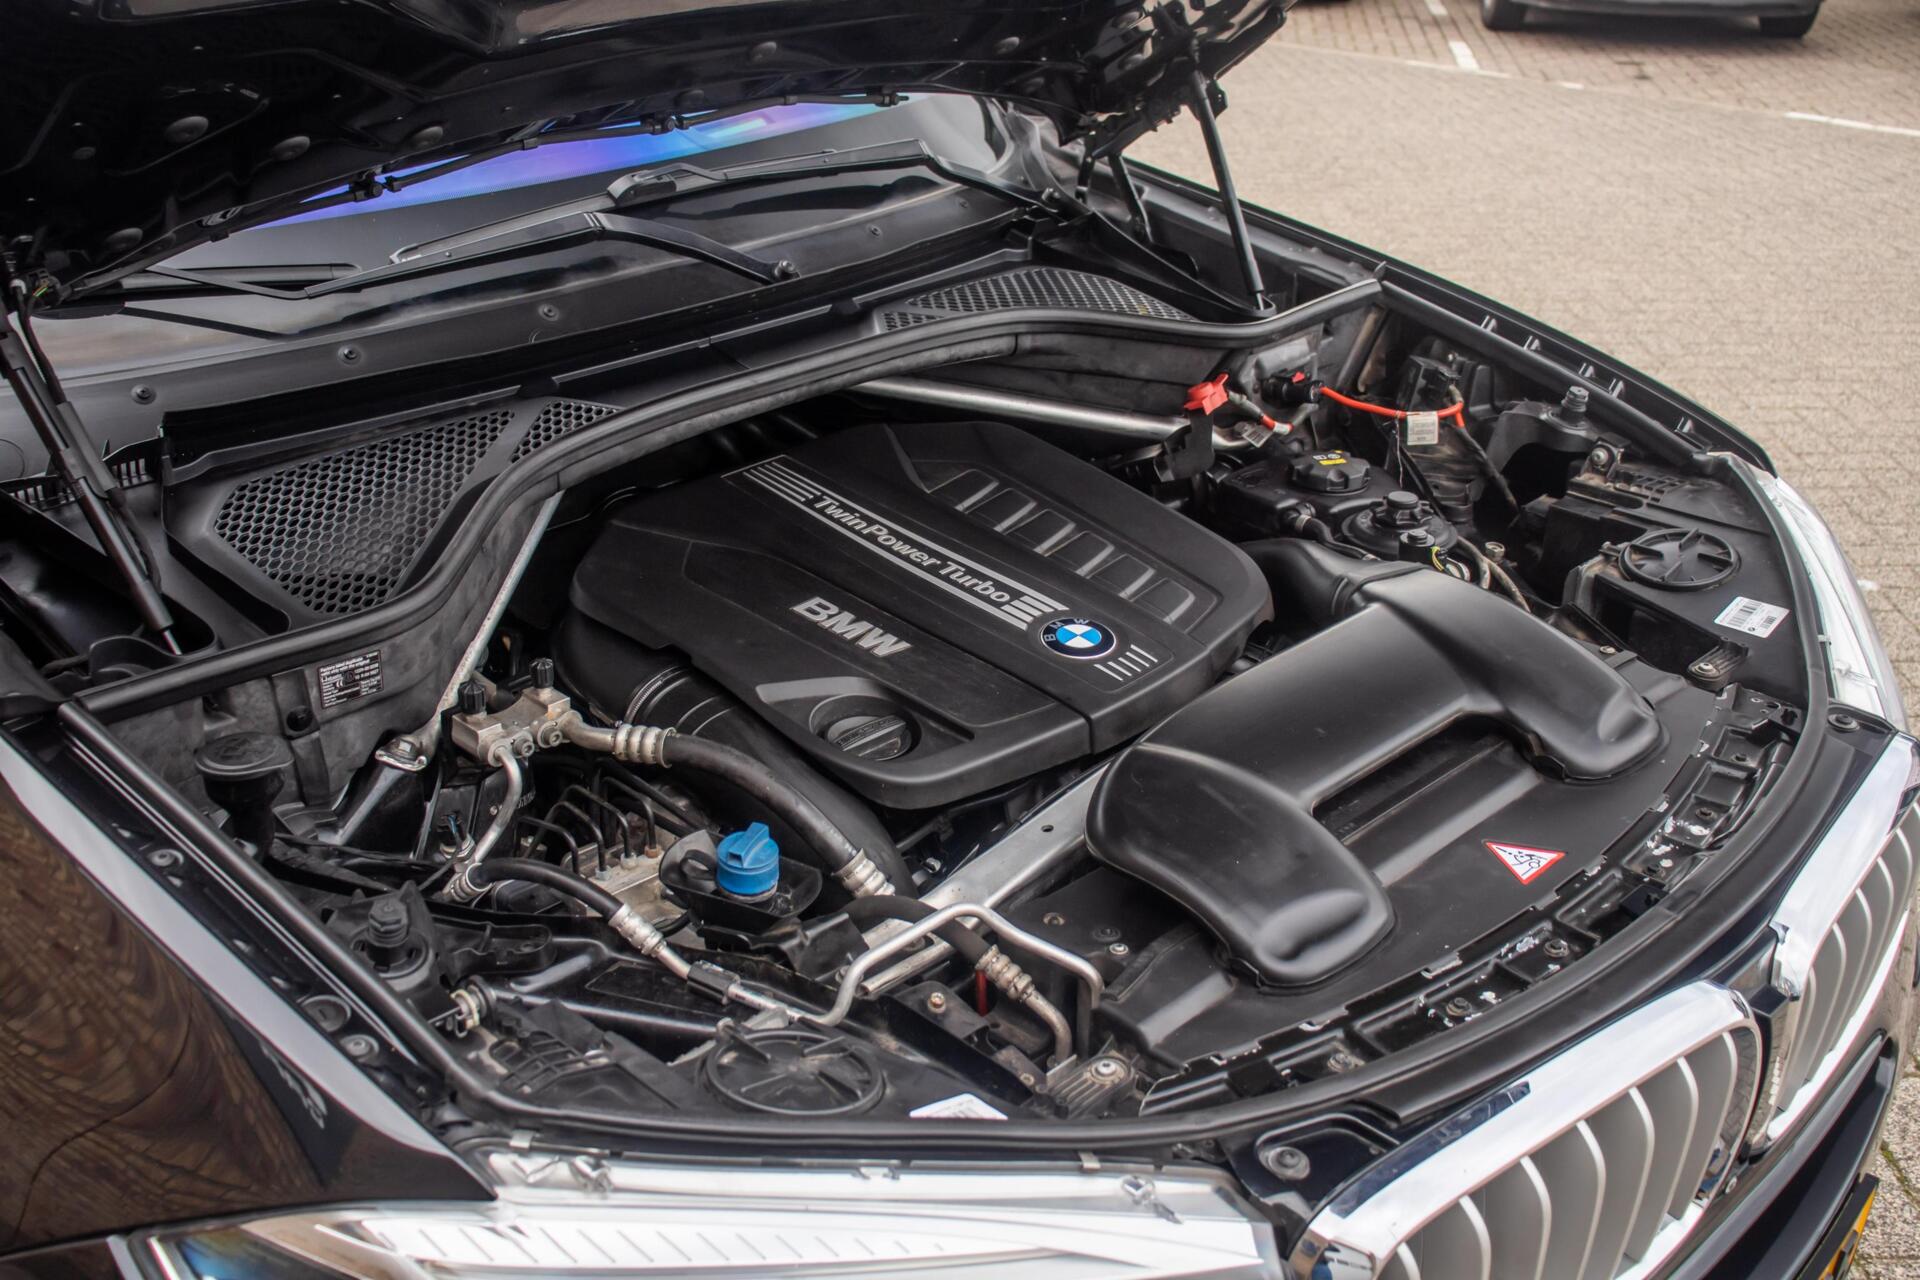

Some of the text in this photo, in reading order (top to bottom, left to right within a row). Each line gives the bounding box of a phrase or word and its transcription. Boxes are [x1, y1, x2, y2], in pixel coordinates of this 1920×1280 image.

[814, 495, 1010, 602] TwinPower Turbo
[789, 596, 912, 657] BMW
